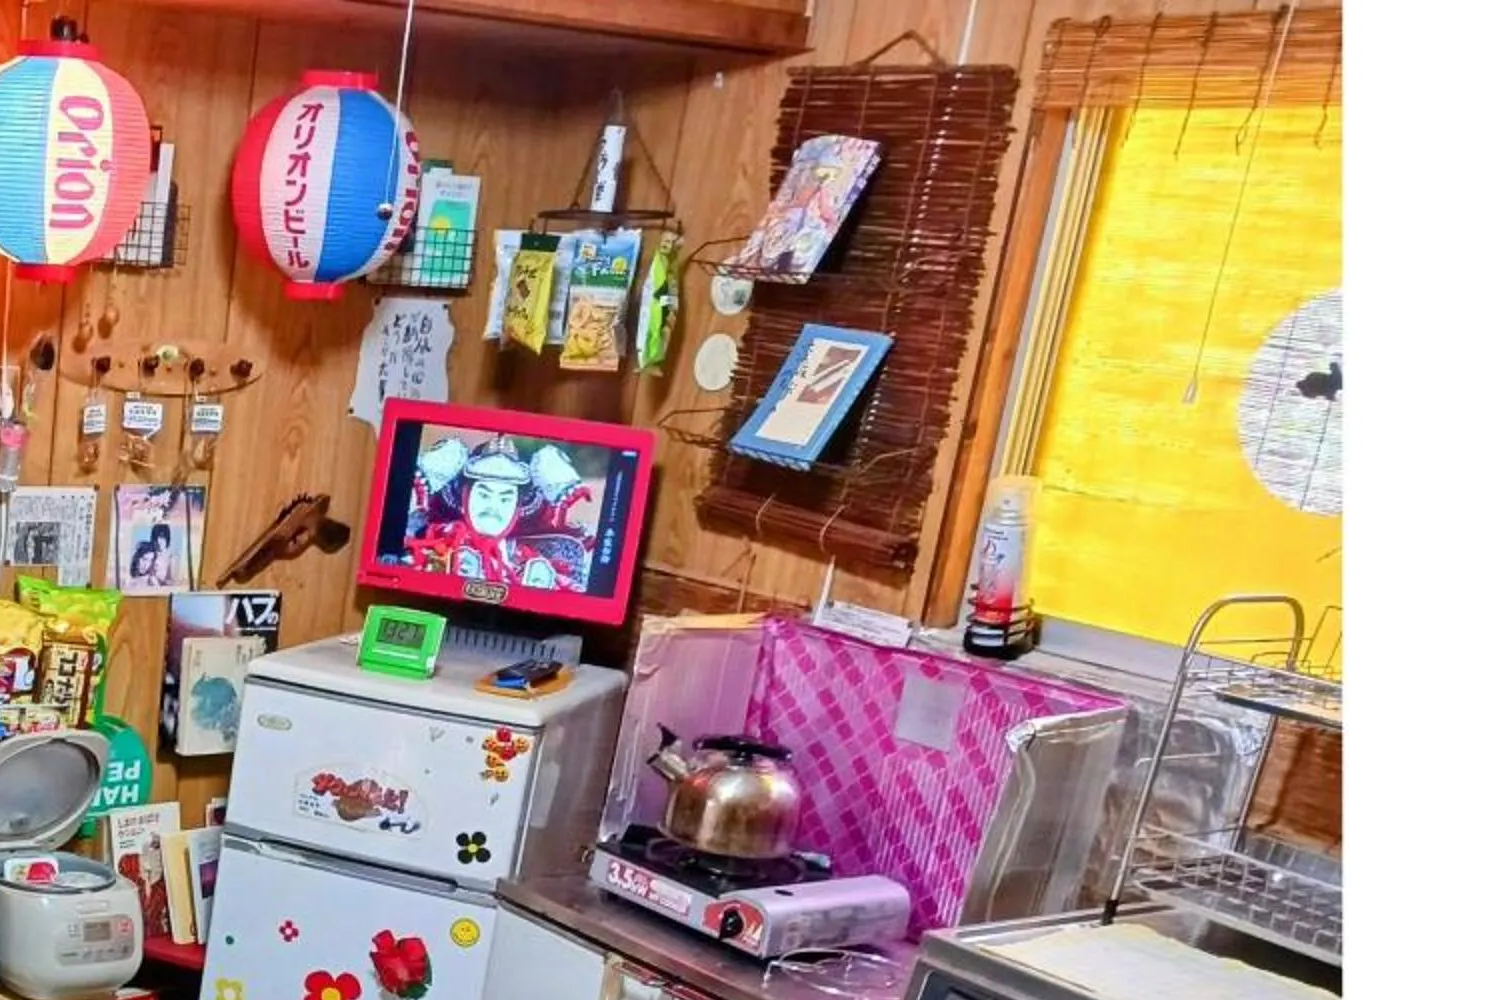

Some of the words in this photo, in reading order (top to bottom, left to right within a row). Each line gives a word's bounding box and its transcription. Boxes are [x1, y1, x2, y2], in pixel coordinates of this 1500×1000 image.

[48, 95, 114, 229] Orion
[283, 102, 325, 269] オリオンビール
[226, 597, 279, 626] ハブの
